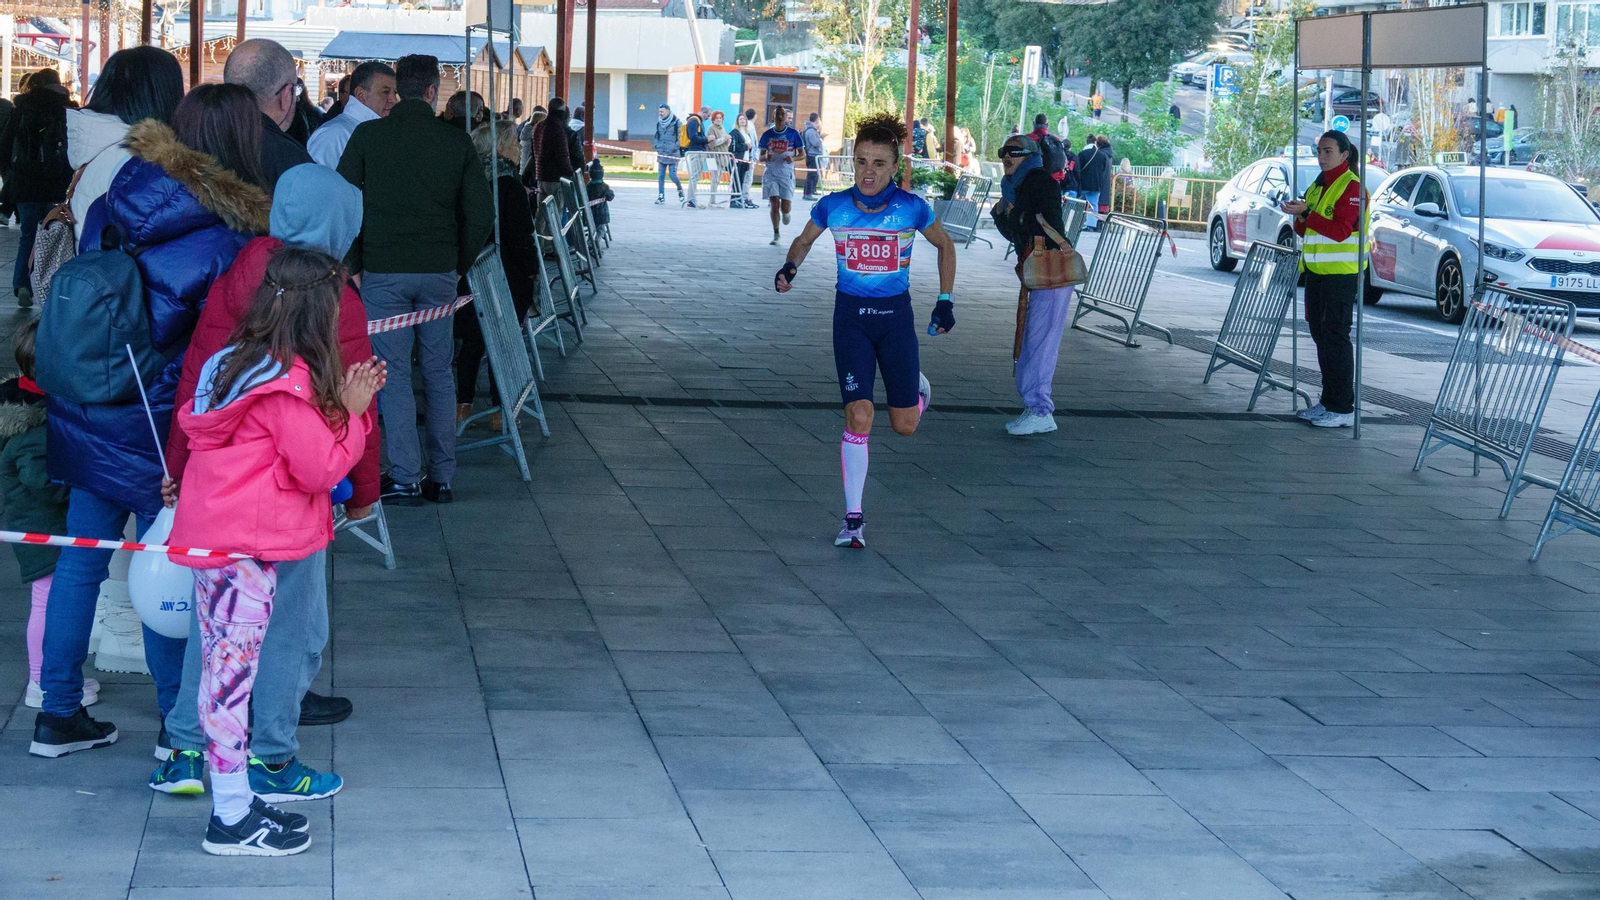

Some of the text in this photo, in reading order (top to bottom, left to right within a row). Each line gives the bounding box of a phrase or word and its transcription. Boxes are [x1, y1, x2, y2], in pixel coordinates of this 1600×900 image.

[1443, 154, 1459, 162] TAXI
[861, 244, 890, 258] 808
[857, 263, 888, 271] Alcampo
[1558, 277, 1600, 289] 9175 LL
